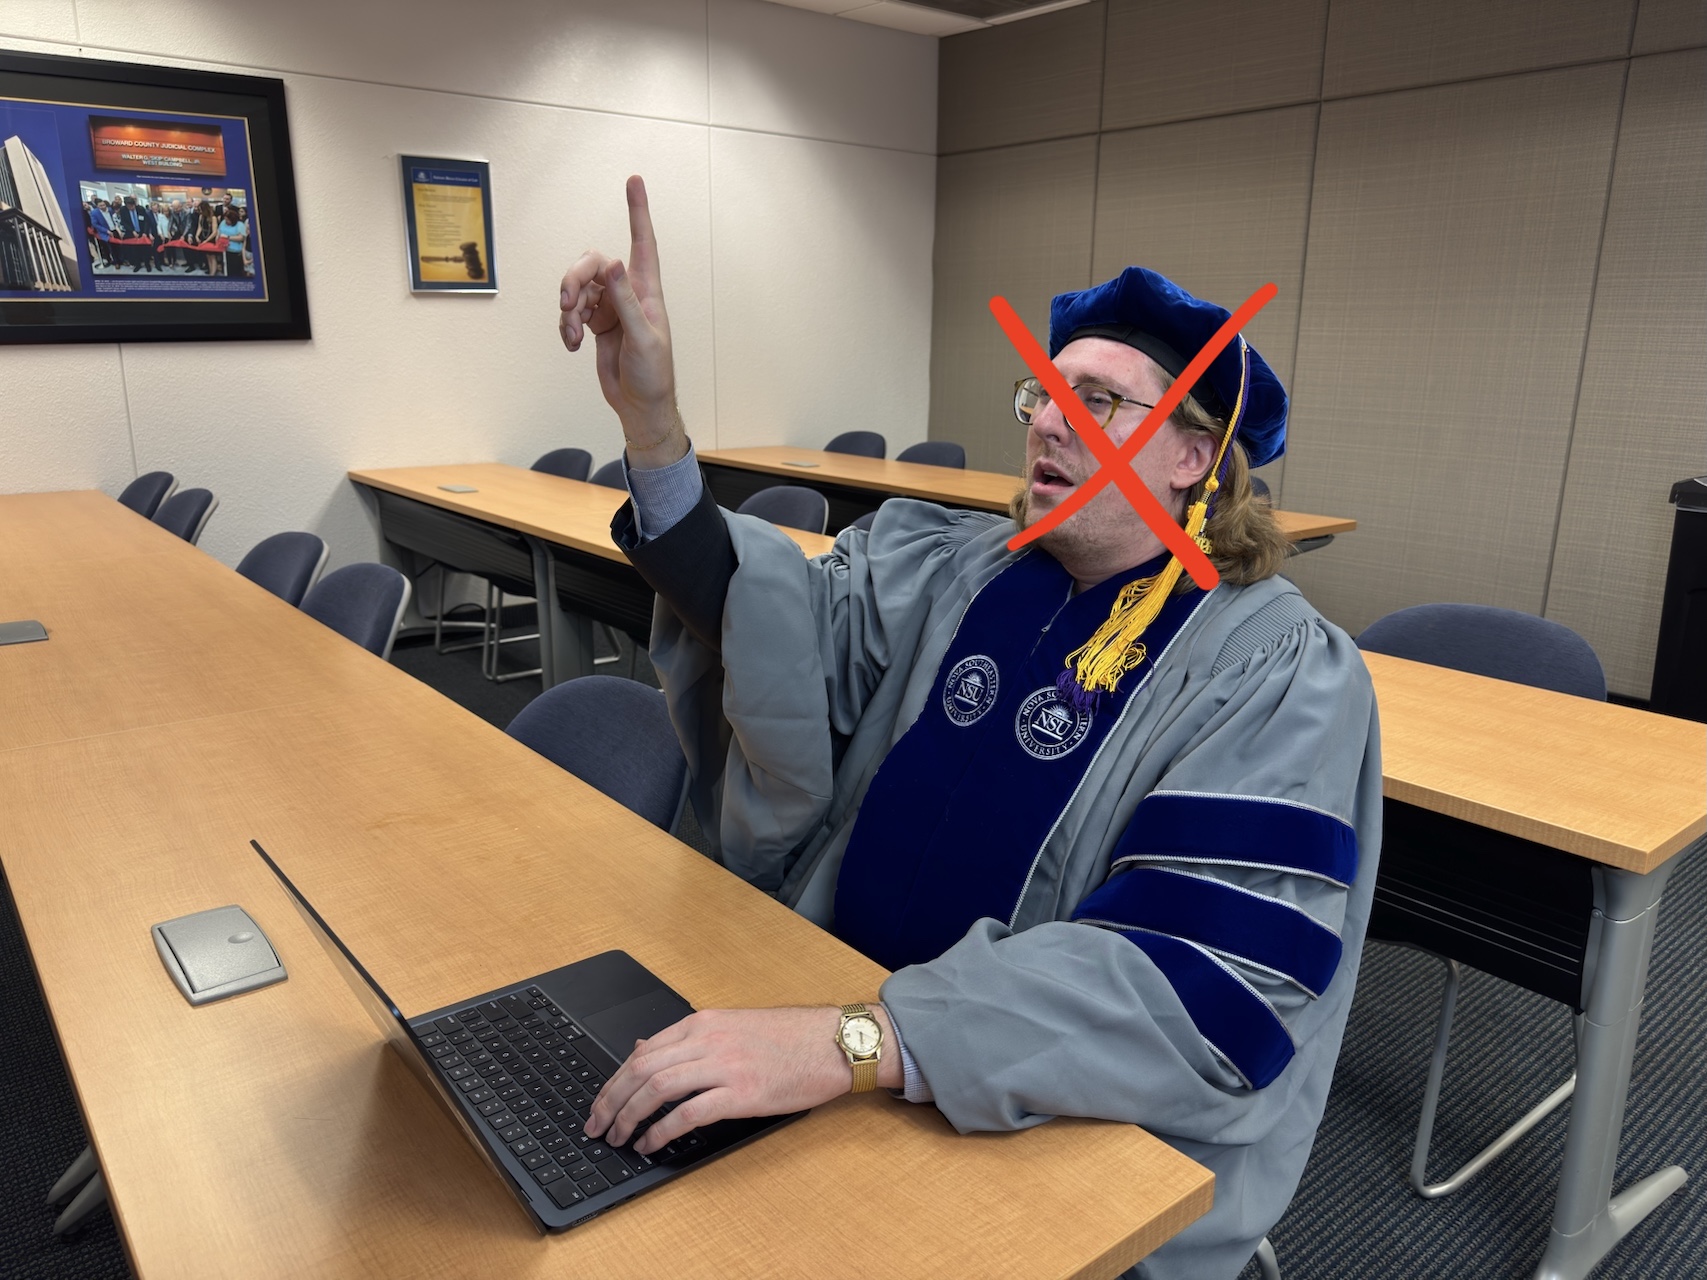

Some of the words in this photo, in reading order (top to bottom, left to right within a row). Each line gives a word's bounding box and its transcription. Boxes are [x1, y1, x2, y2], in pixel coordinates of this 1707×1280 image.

[101, 139, 133, 147] BROWARD
[160, 143, 187, 151] JUDICIAL
[948, 667, 964, 688] NOVA
[956, 680, 984, 701] NSU
[1023, 695, 1044, 716] NOVA
[1034, 711, 1071, 736] NSU
[1020, 724, 1068, 755] UNIVERSITY
